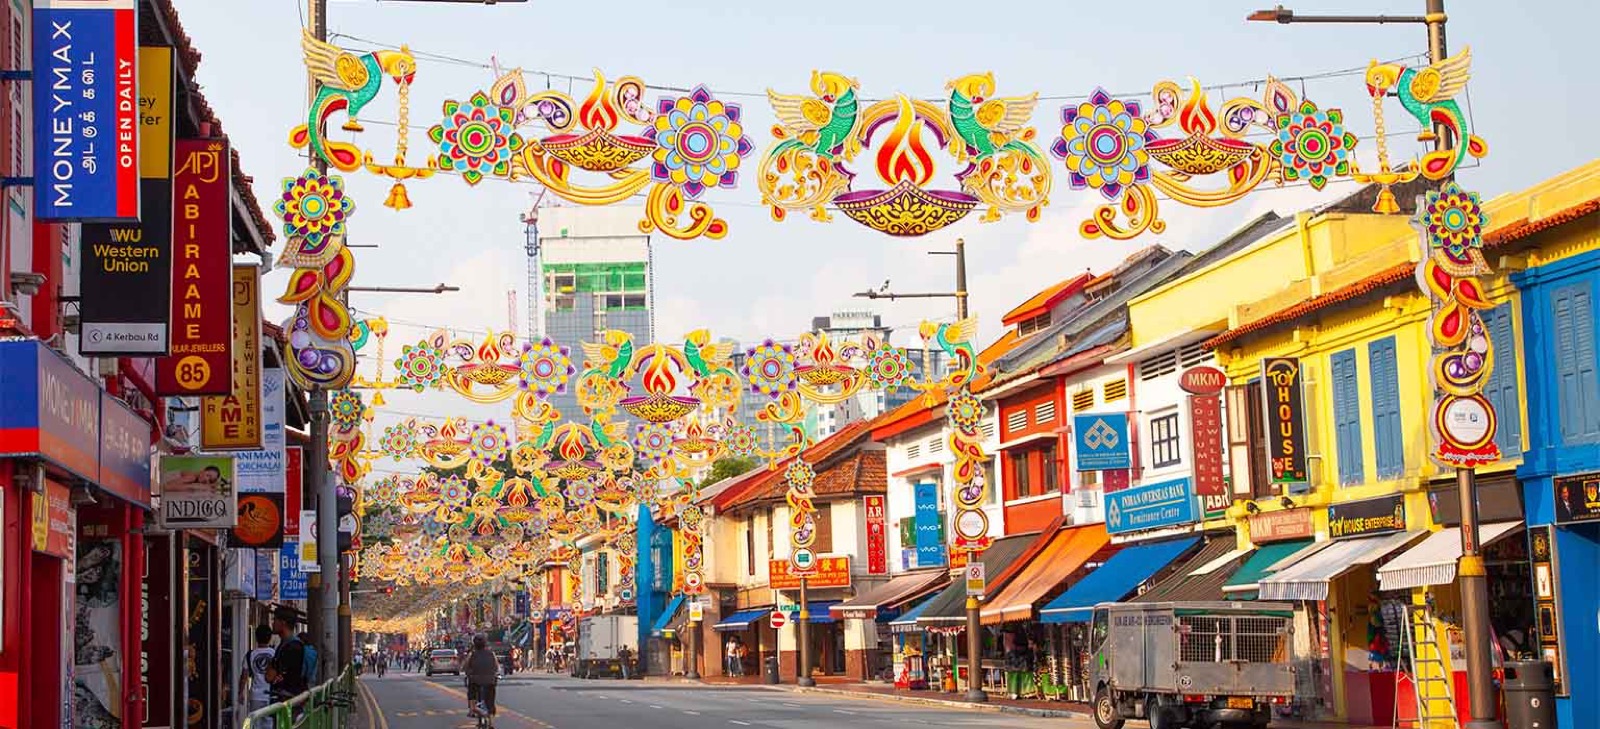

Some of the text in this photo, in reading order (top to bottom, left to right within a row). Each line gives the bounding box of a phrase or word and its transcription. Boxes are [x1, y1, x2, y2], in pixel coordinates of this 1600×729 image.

[139, 97, 156, 109] ey
[52, 20, 73, 207] MONEYMAX
[119, 58, 133, 168] OPEN DAILY
[139, 113, 162, 126] fer
[109, 228, 141, 242] WU
[94, 245, 159, 258] Western
[104, 258, 149, 272] Union
[184, 184, 201, 339] ABIRAAME
[106, 332, 159, 341] 4 Kerbau Rd
[180, 363, 205, 381] 85
[1188, 373, 1220, 386] MKM
[244, 327, 254, 438] JEWELLERS
[1278, 386, 1294, 471] HOUSE
[1122, 483, 1185, 508] INDIAN OVERSEAS BANK
[166, 500, 227, 517] INDIGO
[868, 506, 883, 518] AR
[1344, 517, 1365, 534] HOUSE
[1365, 515, 1395, 530] ENTERPRISE
